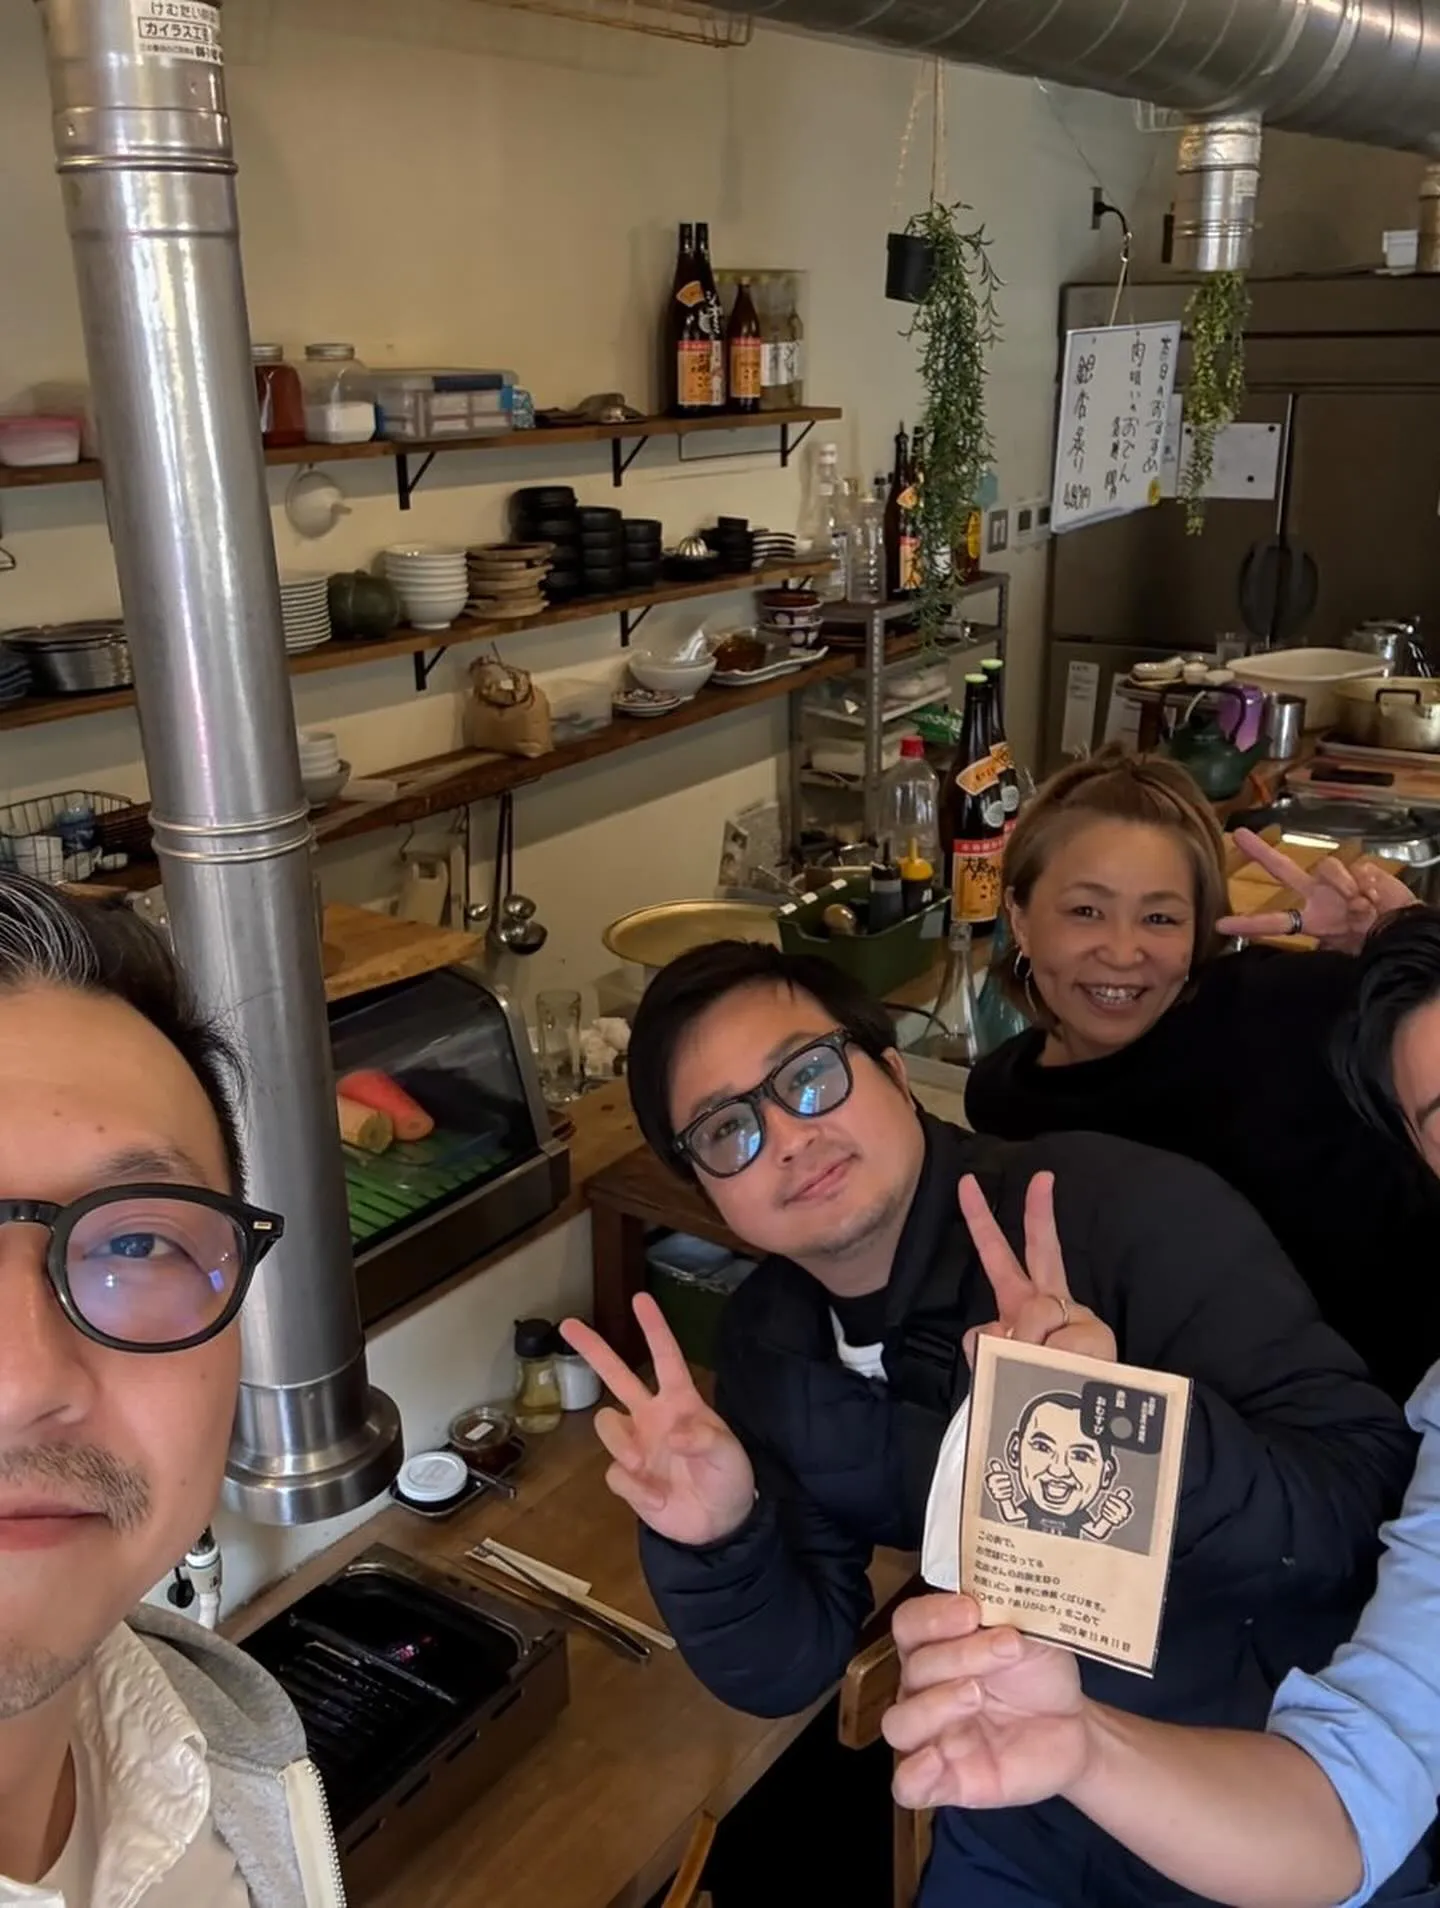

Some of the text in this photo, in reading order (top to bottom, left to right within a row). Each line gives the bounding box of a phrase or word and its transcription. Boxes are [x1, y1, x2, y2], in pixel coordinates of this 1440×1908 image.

[1093, 1395, 1107, 1436] おむすび
[1058, 1622, 1132, 1653] 2025年11月11日
